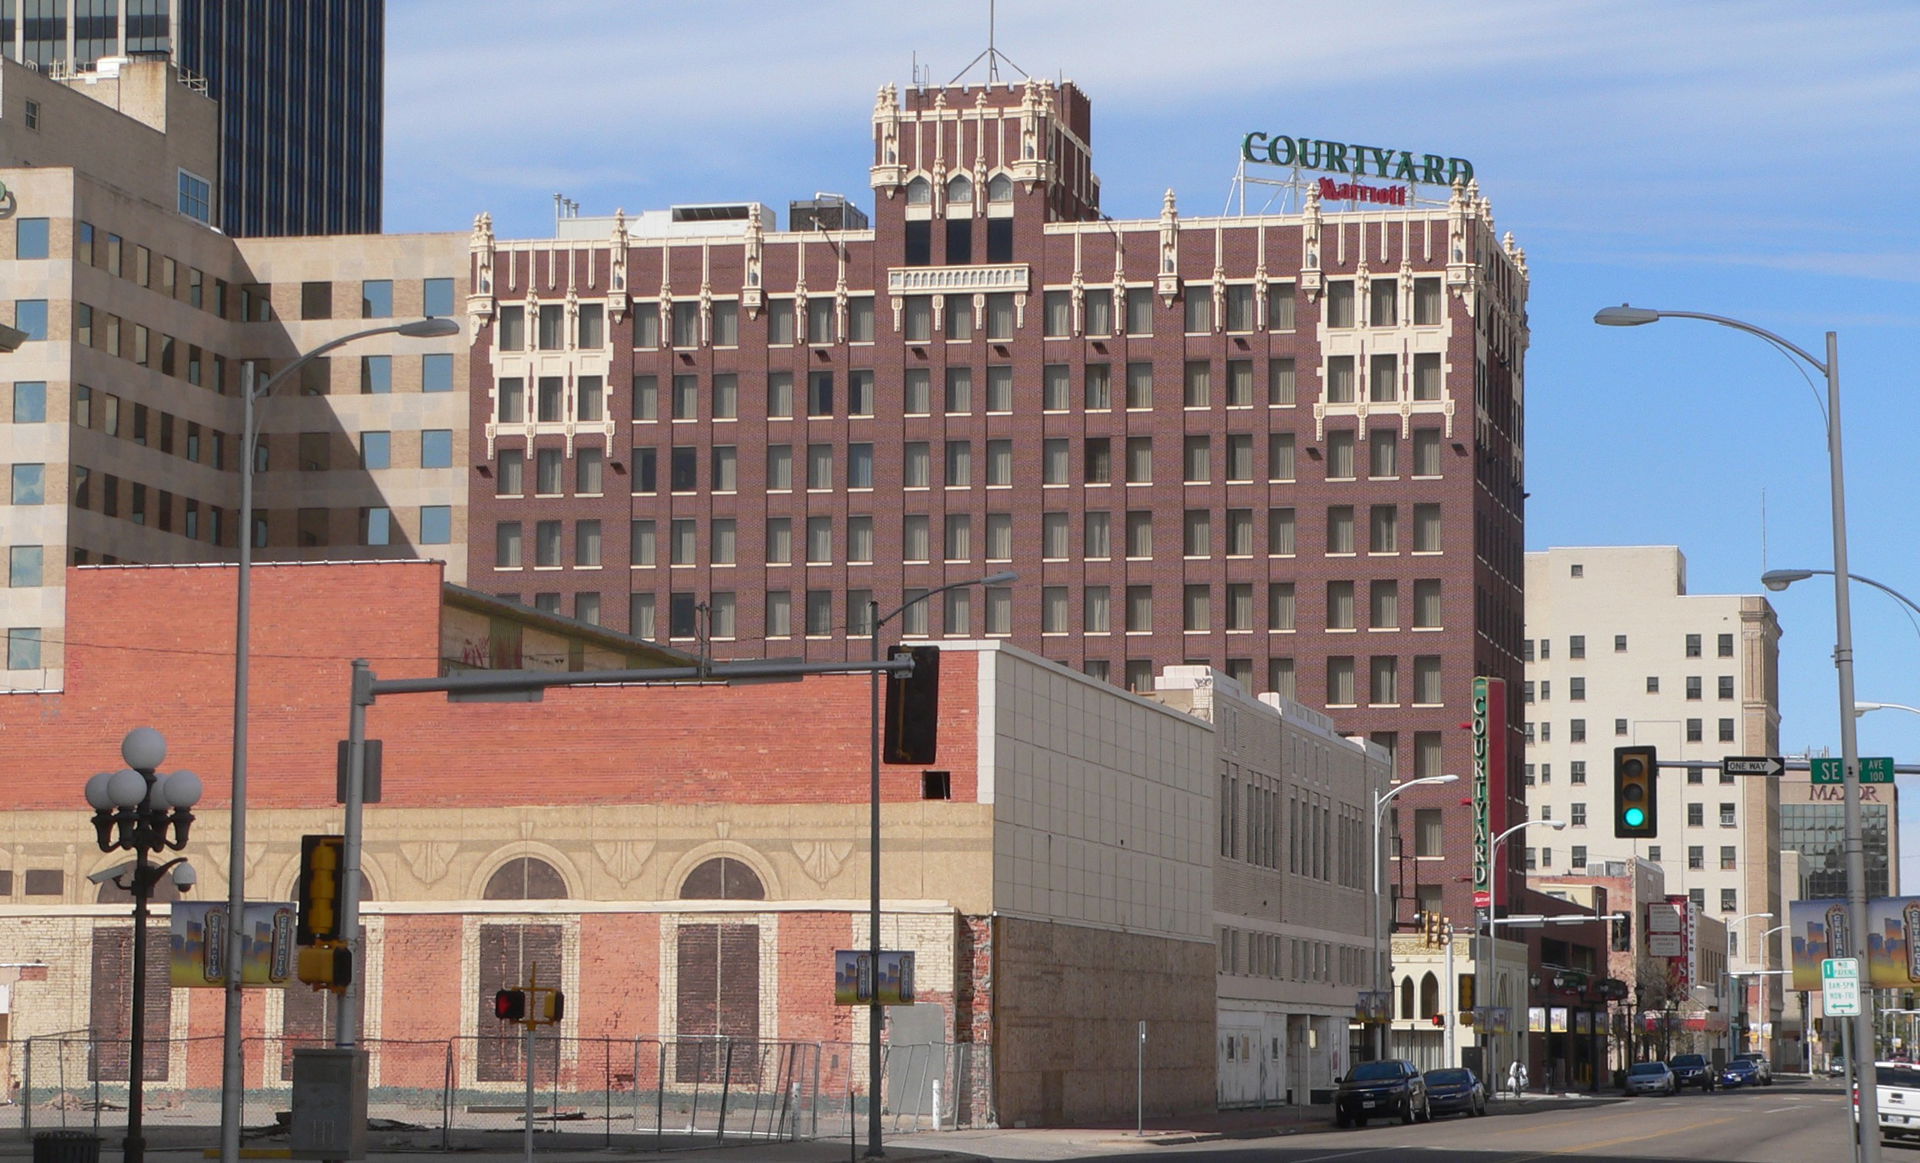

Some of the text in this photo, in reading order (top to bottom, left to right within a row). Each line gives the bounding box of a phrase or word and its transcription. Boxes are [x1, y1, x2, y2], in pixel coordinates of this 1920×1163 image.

[1243, 132, 1474, 187] COURTYARD
[1316, 176, 1406, 206] Marriott
[1729, 761, 1767, 770] ONE WAY
[1821, 762, 1840, 781] SE
[1868, 760, 1884, 770] AVE
[1870, 771, 1885, 782] 100
[1472, 696, 1487, 885] COURTYARD
